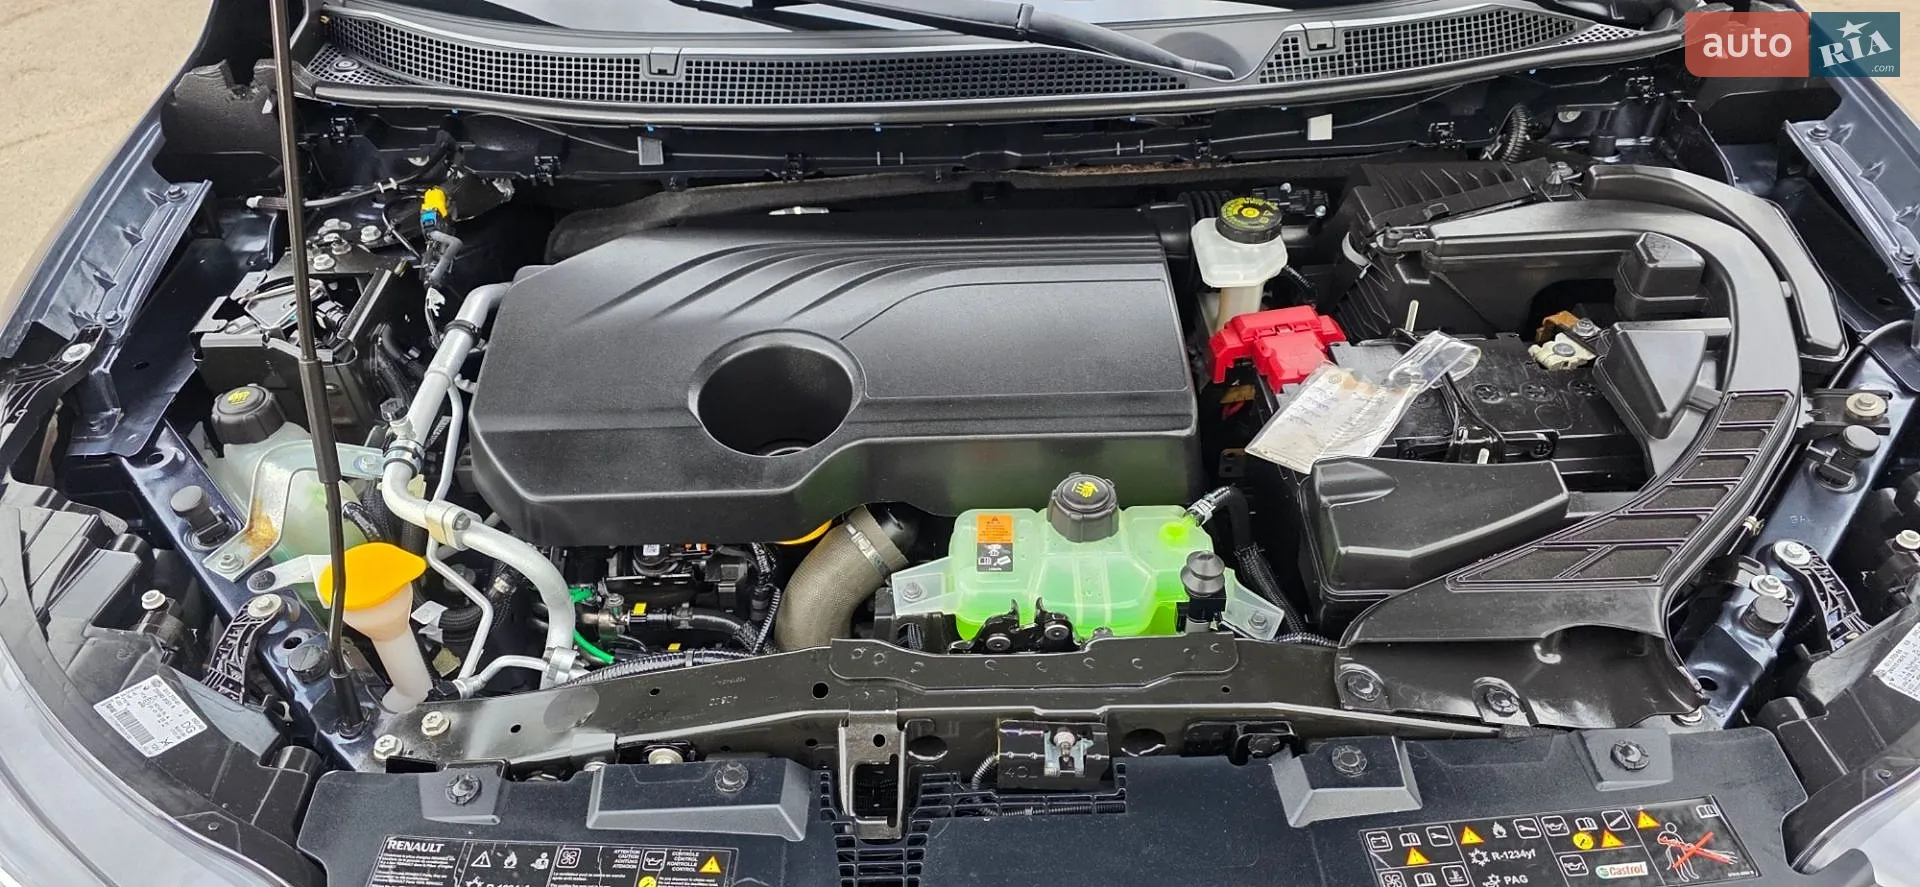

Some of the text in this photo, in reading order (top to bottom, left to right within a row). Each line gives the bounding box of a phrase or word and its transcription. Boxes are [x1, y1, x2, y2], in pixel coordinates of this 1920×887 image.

[387, 840, 445, 853] RENAULT
[1491, 848, 1537, 861] R-1234yf
[1608, 863, 1646, 877] Castrol
[1503, 874, 1529, 885] PAG
